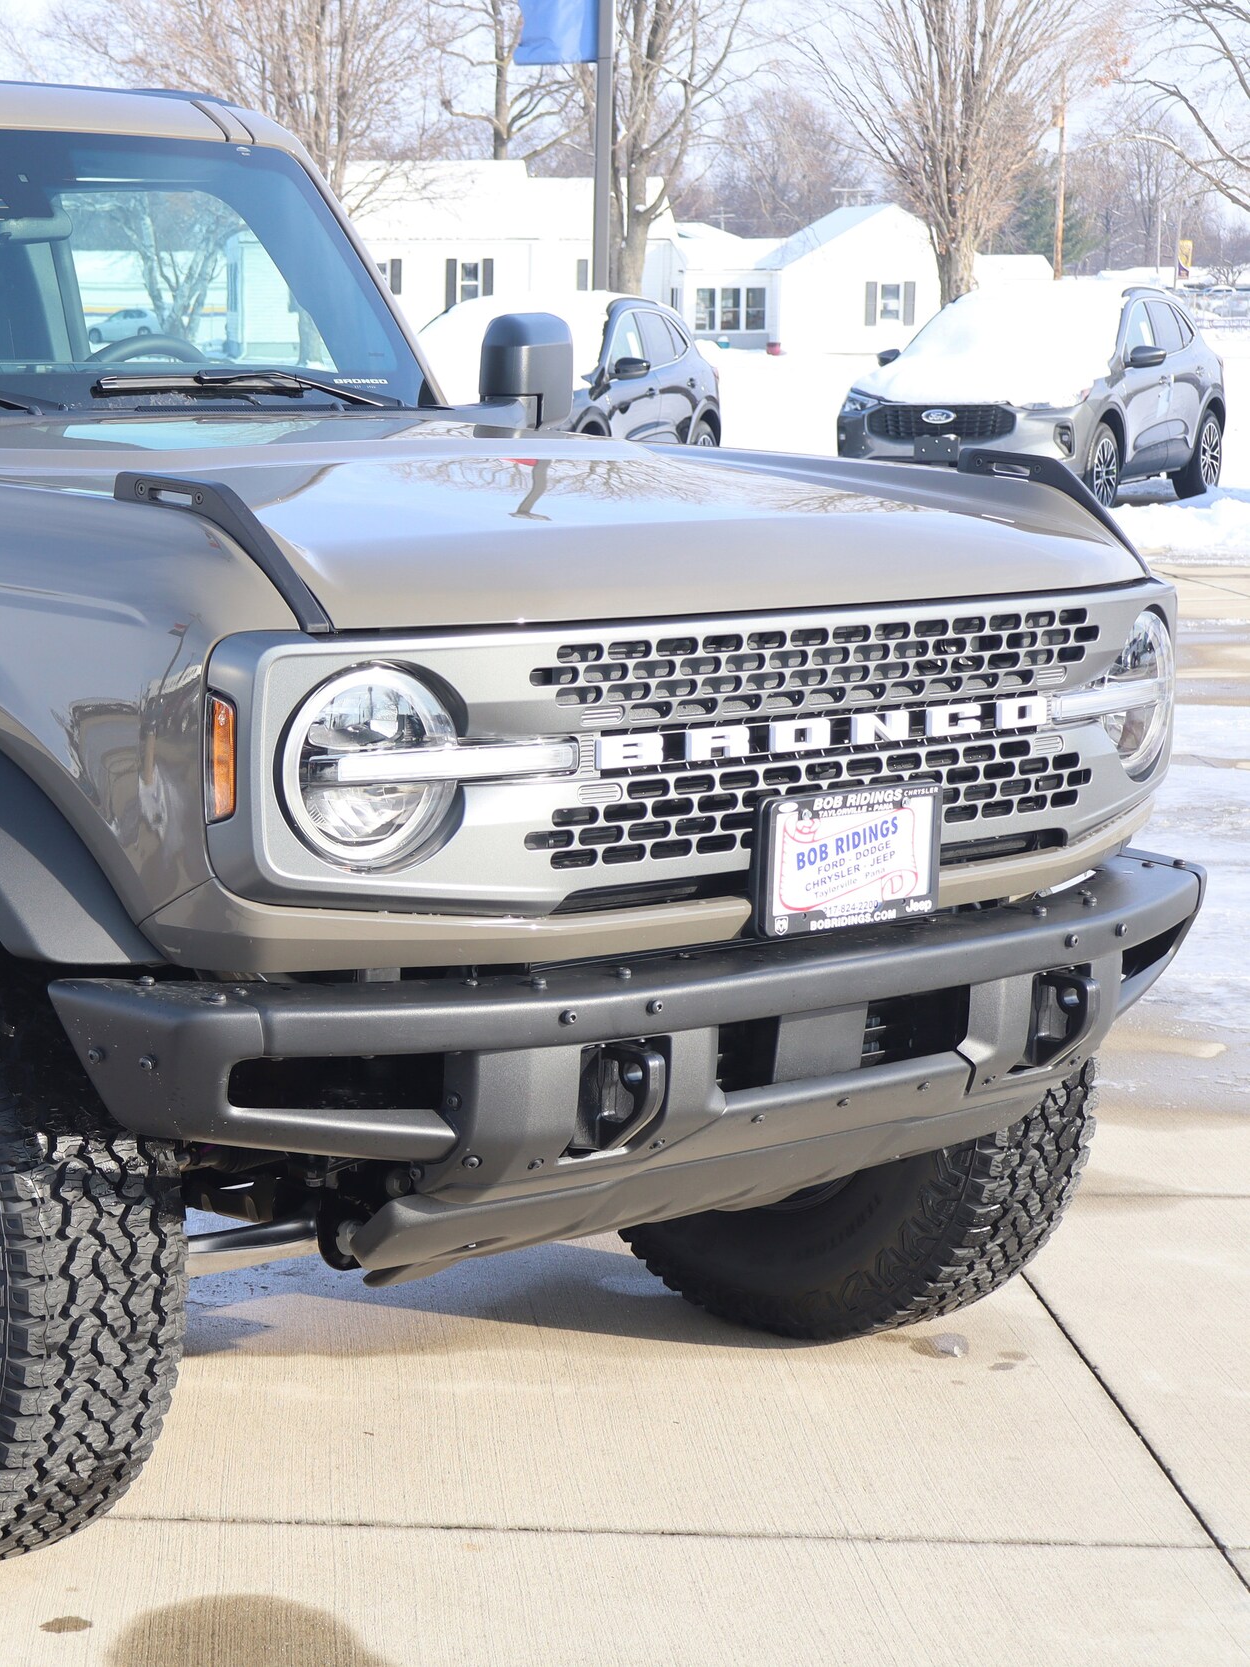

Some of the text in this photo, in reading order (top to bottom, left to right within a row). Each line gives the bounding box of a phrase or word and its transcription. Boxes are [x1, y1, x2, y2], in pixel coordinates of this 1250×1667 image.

[595, 695, 1048, 770] BRONCO
[813, 788, 903, 811] BOB RIDINGS
[903, 786, 939, 797] CHRYSLER
[818, 805, 868, 818] TAYLORVILLE
[873, 802, 894, 812] PANA
[796, 816, 898, 871] BOB RIDINGS
[805, 864, 861, 892] CHRYSLER
[870, 850, 896, 867] JEEP
[817, 858, 846, 875] FORD
[855, 840, 892, 860] DODGE
[814, 867, 886, 899] Taylorville Pana
[905, 898, 932, 912] Jeep
[810, 908, 897, 931] BOBRIDINGS.COM
